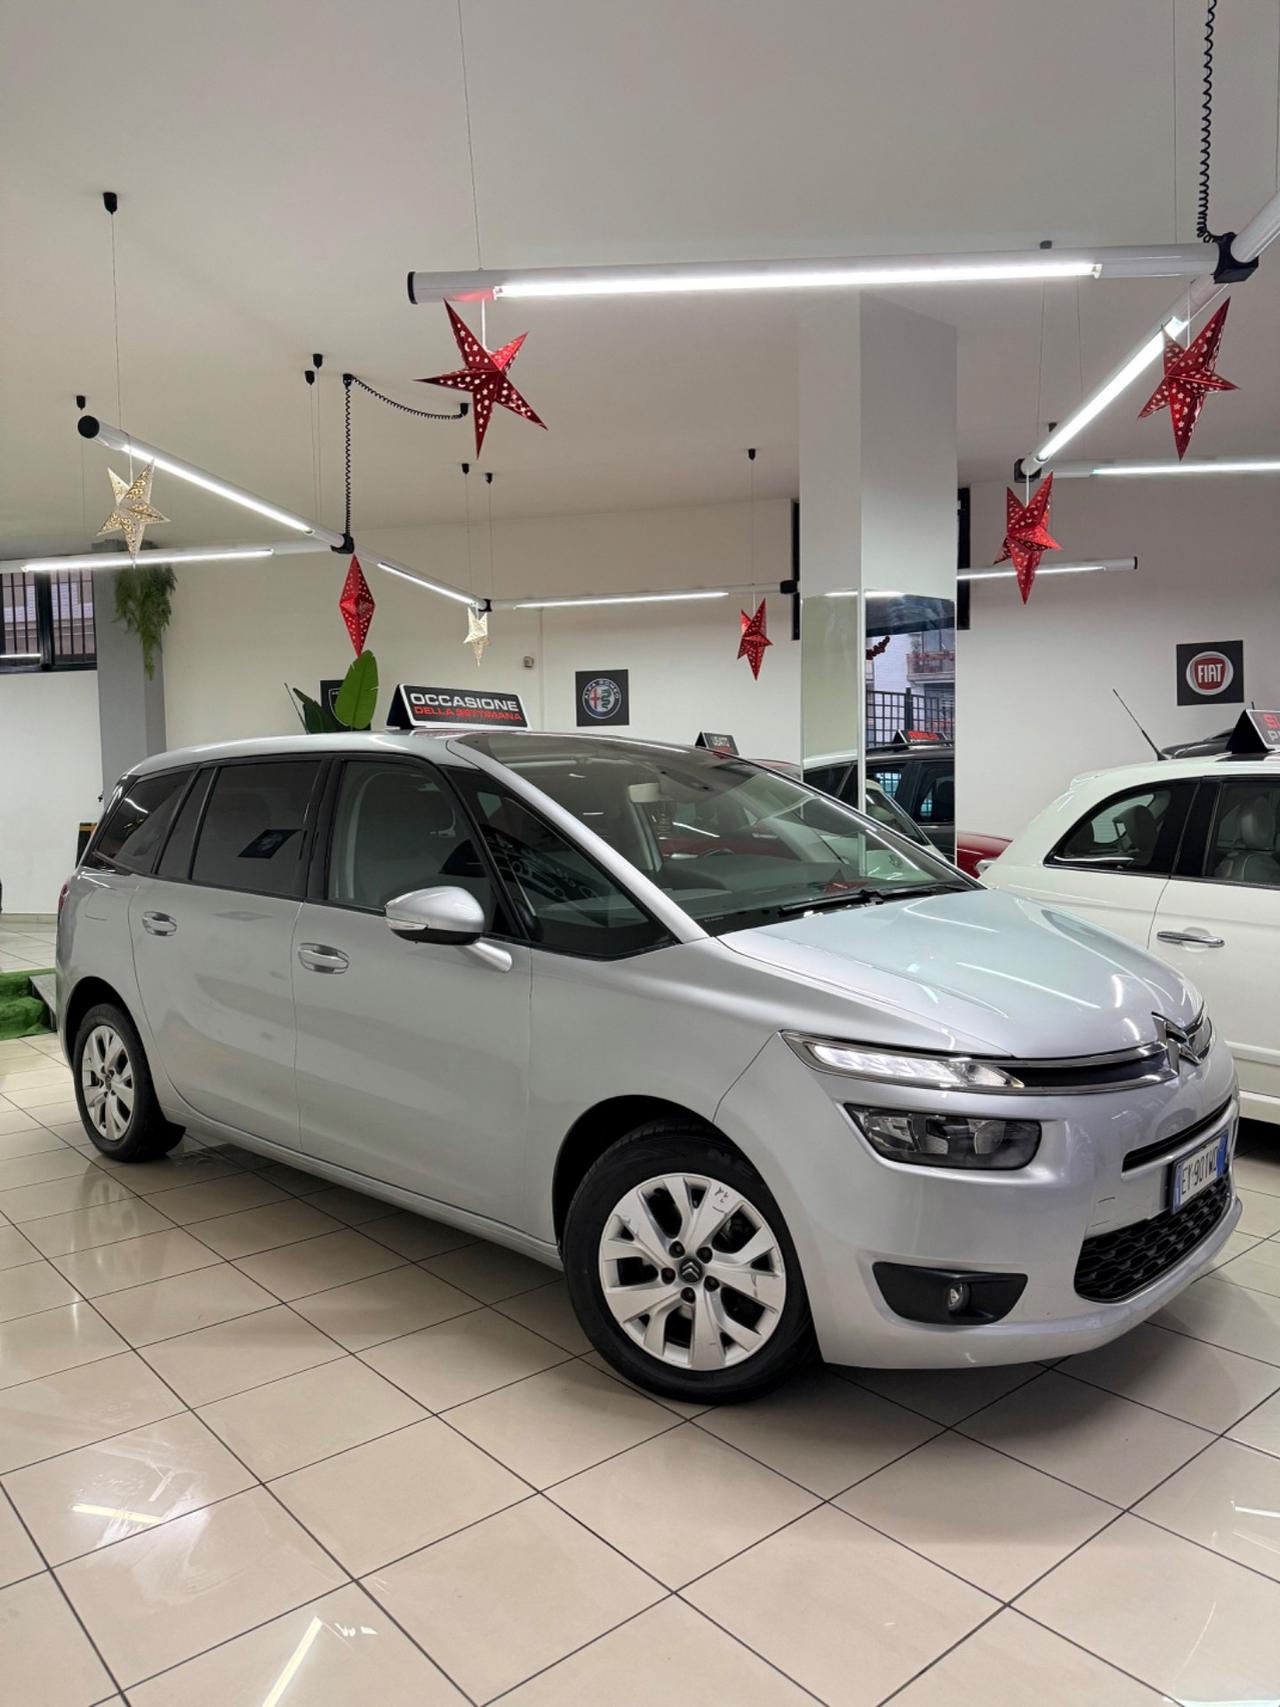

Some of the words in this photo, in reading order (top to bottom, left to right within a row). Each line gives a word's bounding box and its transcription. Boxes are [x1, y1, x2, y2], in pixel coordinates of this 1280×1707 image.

[1197, 664, 1224, 684] FIAT
[410, 693, 519, 712] OCCASIONE
[414, 705, 453, 717] DELLA
[455, 708, 523, 721] SETTIMANA
